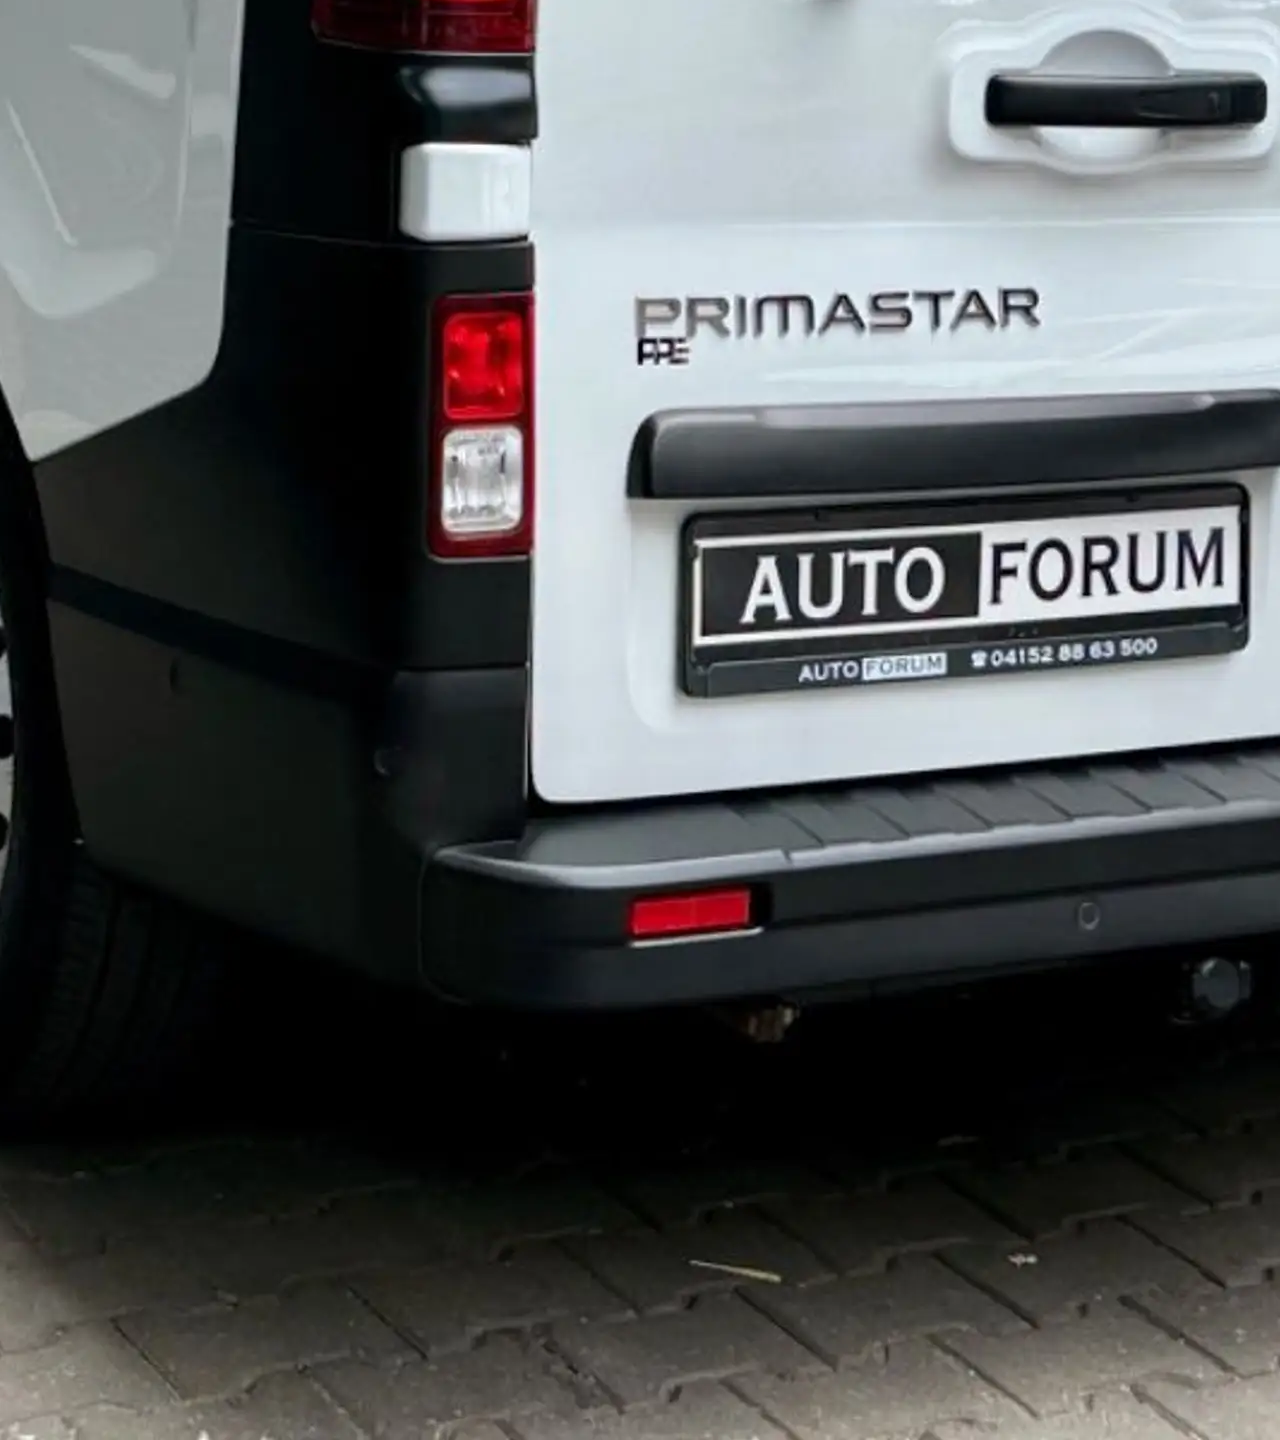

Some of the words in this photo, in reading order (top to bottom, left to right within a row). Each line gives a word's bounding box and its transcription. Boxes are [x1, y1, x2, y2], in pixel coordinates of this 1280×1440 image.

[634, 287, 1041, 338] PRIMASTAR
[739, 546, 946, 623] AUTO
[988, 526, 1225, 605] FORUM
[798, 661, 860, 683] AUTO
[866, 655, 943, 677] FORUM
[990, 646, 1055, 667] 04152
[1058, 643, 1085, 662] 88
[1089, 640, 1115, 659] 63
[1120, 637, 1158, 657] 500
